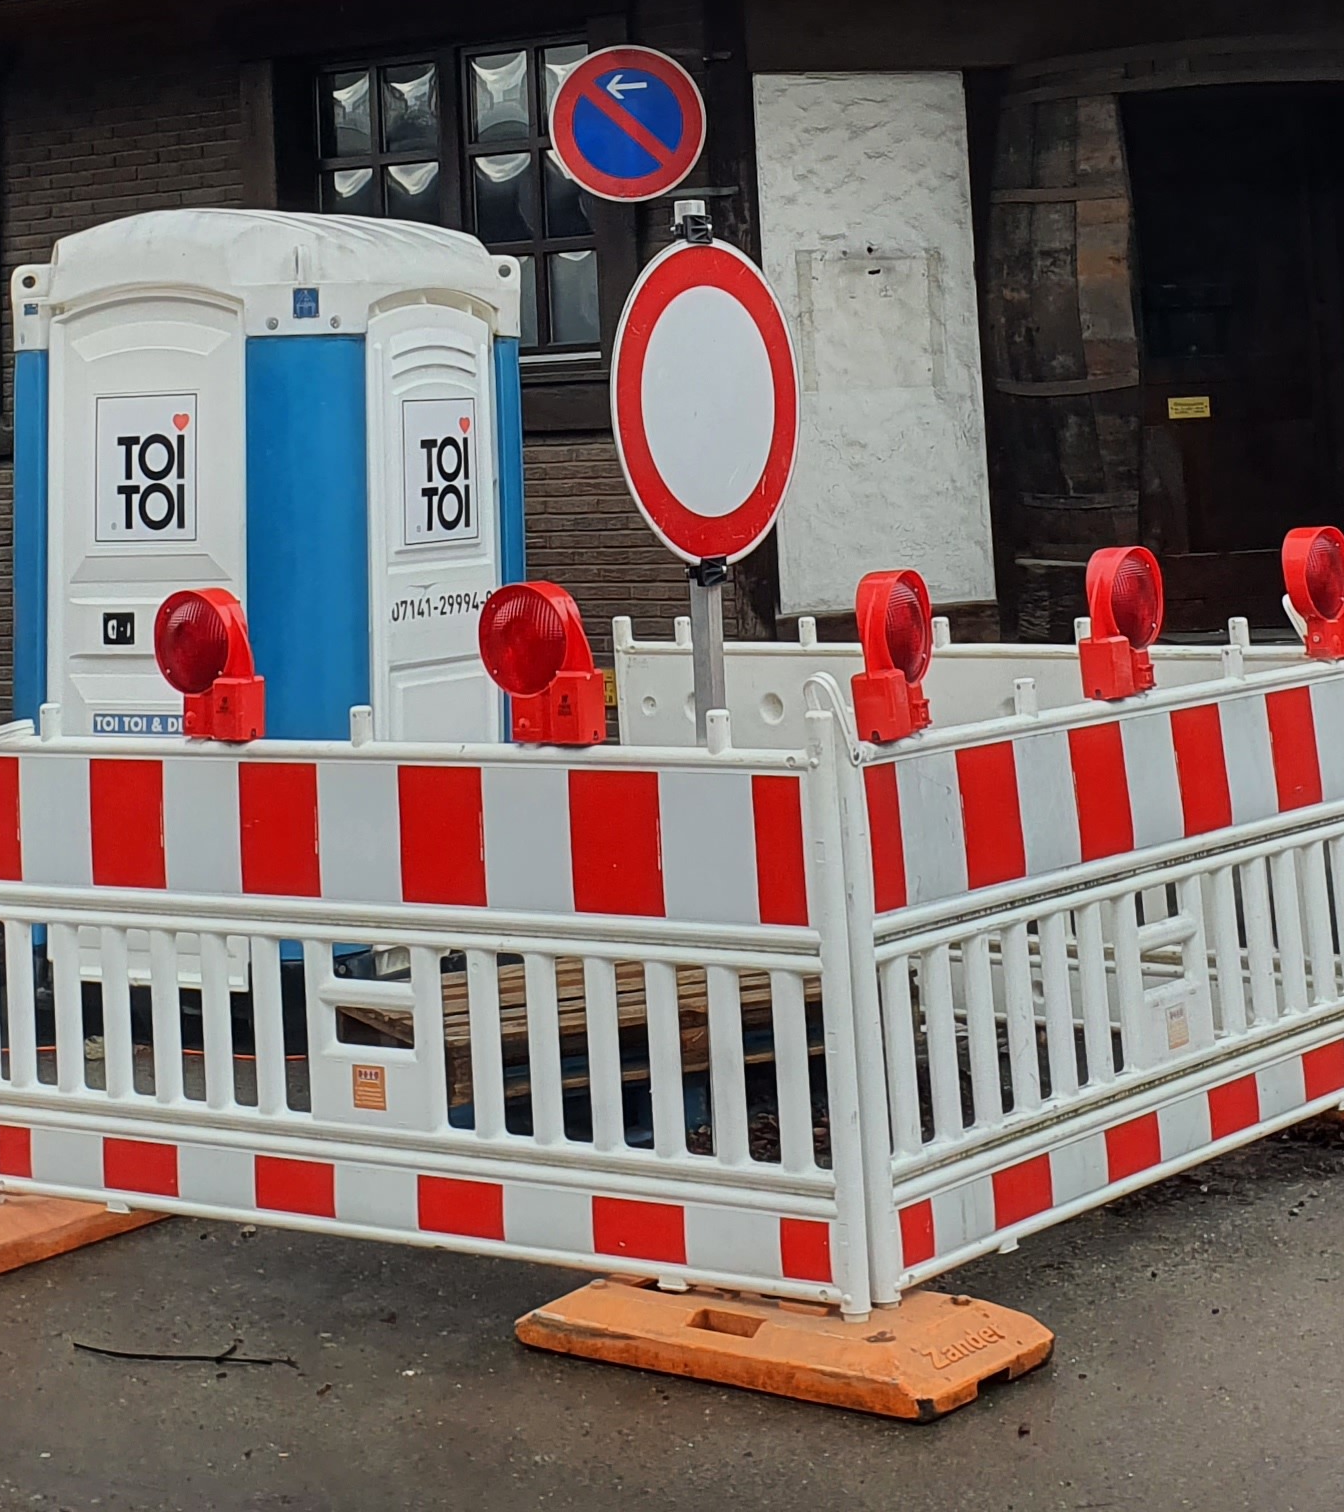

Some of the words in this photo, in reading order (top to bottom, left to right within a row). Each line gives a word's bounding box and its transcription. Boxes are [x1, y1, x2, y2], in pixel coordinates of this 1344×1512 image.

[117, 433, 185, 481] TOI
[420, 436, 470, 483] TOI
[117, 482, 185, 531] TOI
[421, 484, 471, 531] TOI
[95, 716, 118, 732] TOI
[123, 716, 146, 732] TOI
[920, 1322, 1007, 1371] Zander
